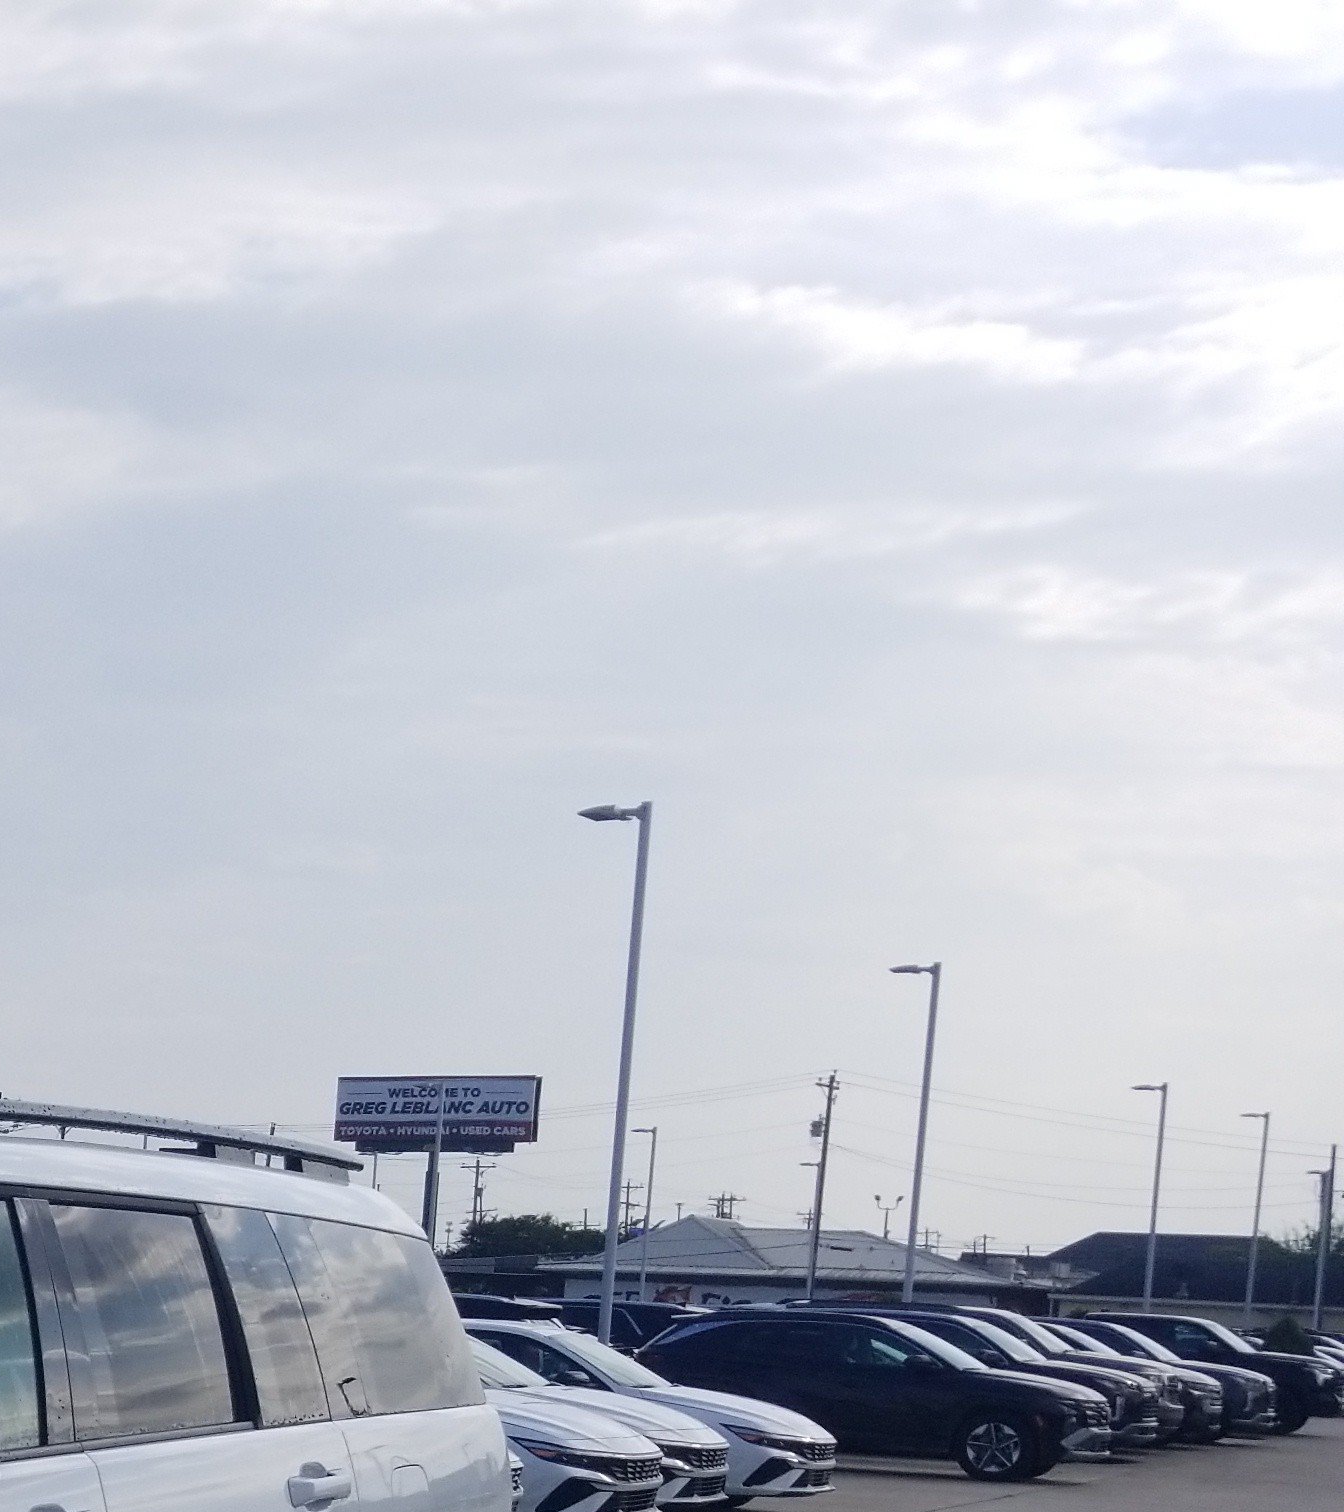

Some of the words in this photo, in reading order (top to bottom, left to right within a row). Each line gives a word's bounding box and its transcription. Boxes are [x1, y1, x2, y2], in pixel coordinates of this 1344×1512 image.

[462, 1087, 482, 1098] TO
[339, 1101, 387, 1115] GREG
[476, 1100, 530, 1115] AUTO
[339, 1126, 387, 1136] TOYOTA
[459, 1126, 491, 1136] USED
[493, 1126, 526, 1136] CARS
